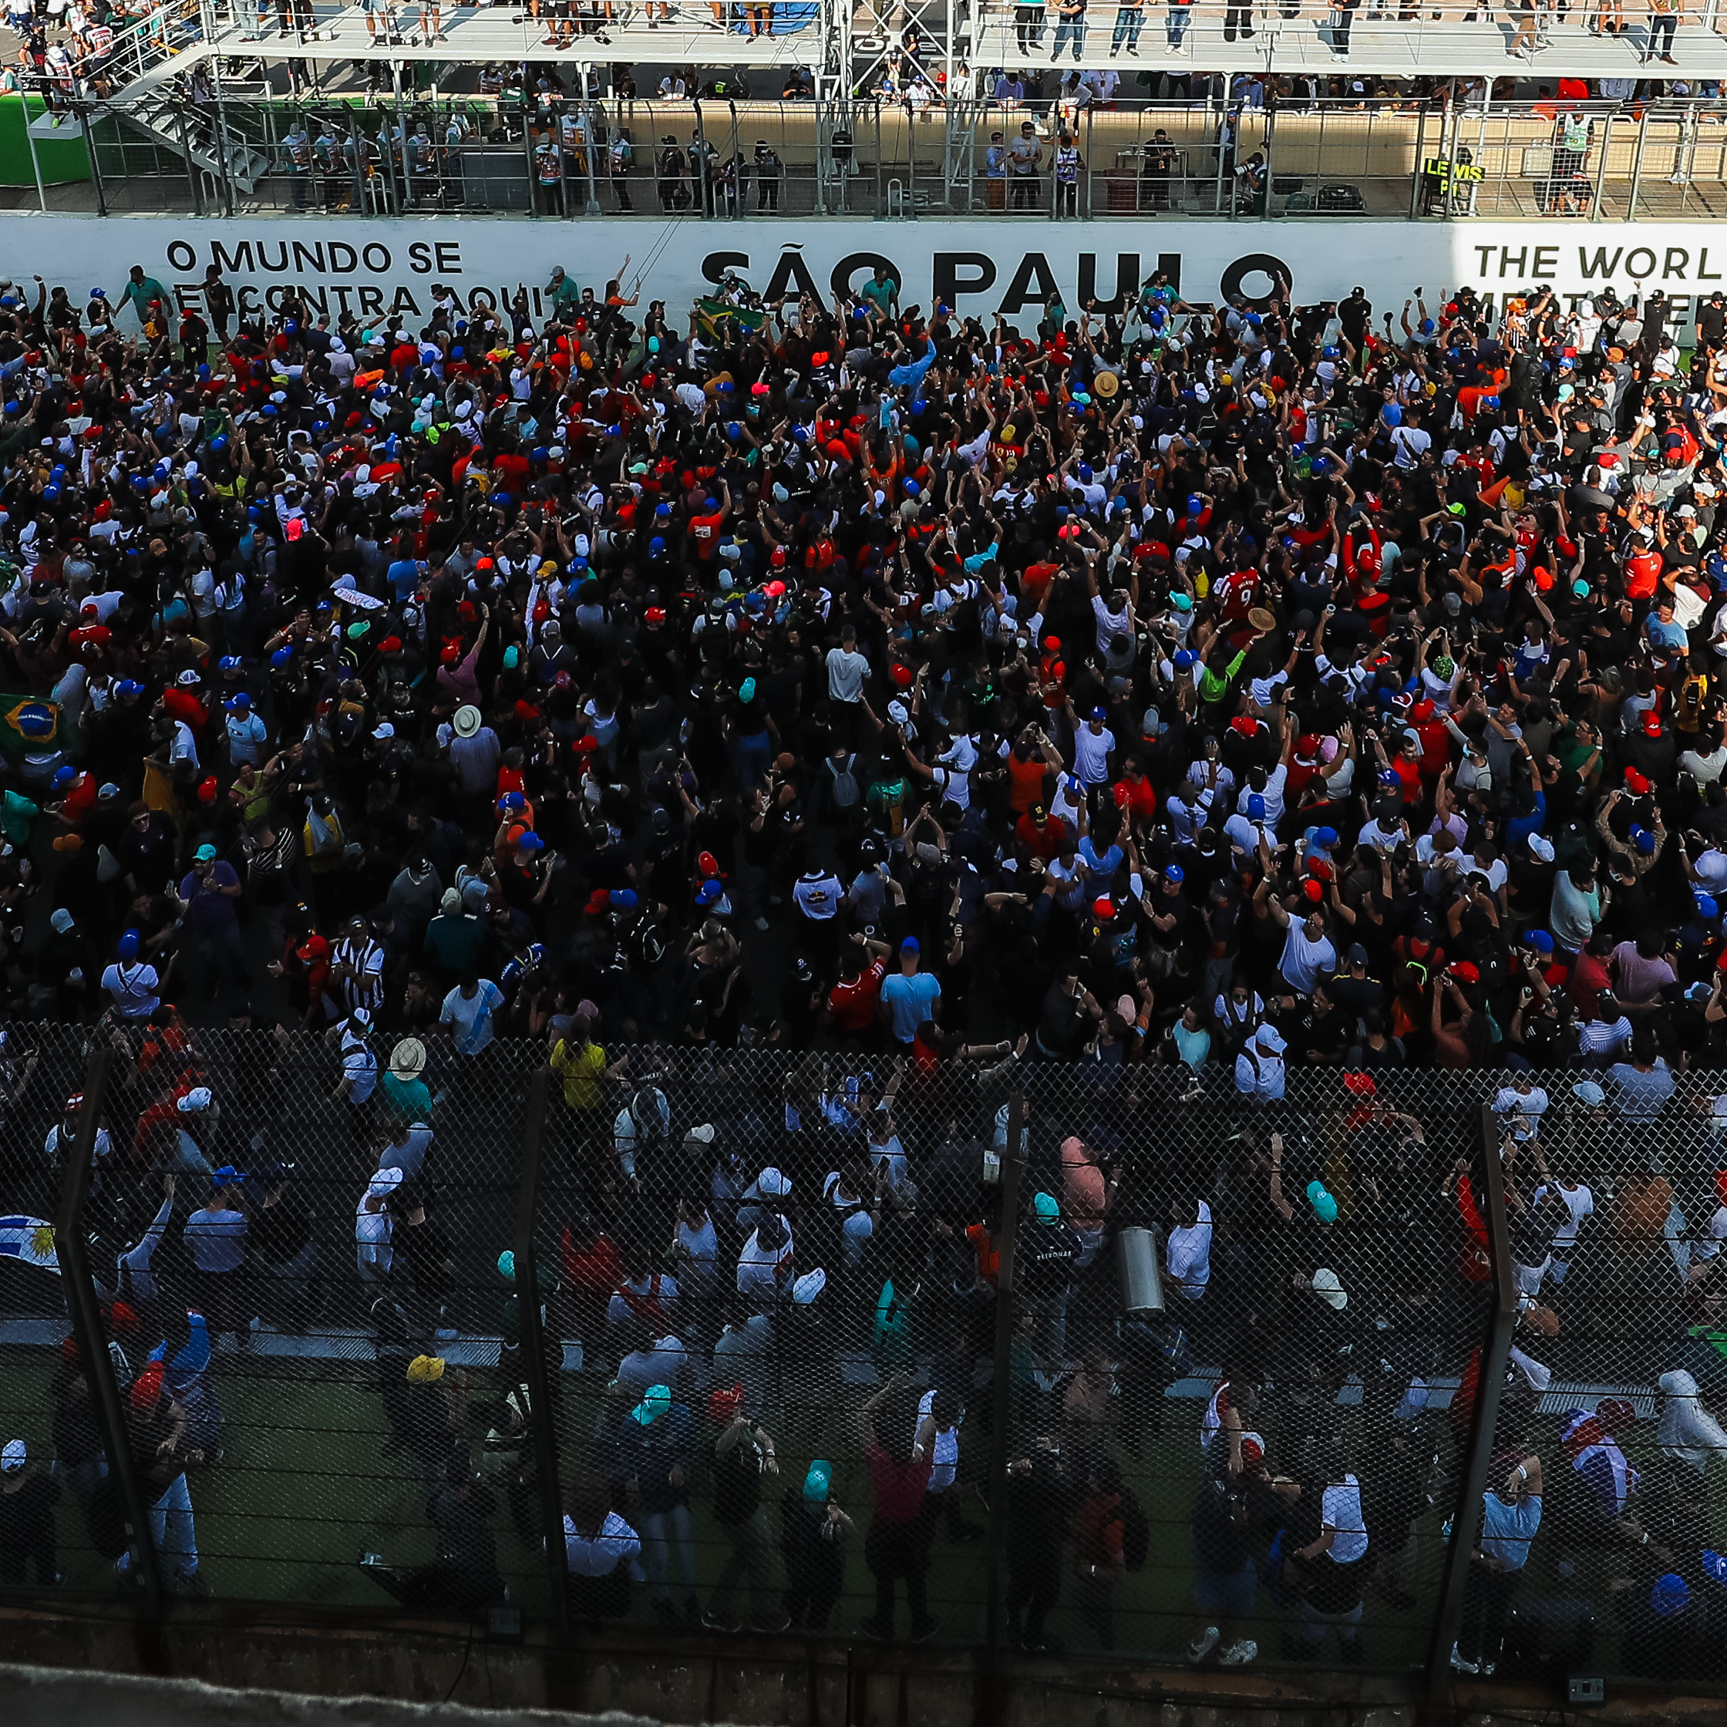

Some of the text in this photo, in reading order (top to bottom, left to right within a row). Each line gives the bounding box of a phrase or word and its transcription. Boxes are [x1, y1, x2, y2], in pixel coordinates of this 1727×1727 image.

[1428, 159, 1484, 181] LEWIS
[166, 240, 462, 274] O MUNDO SE
[1474, 245, 1560, 278] THE
[701, 242, 1295, 316] SÃO PAULO
[1240, 589, 1252, 607] 9
[1036, 1250, 1072, 1262] PETRONAS
